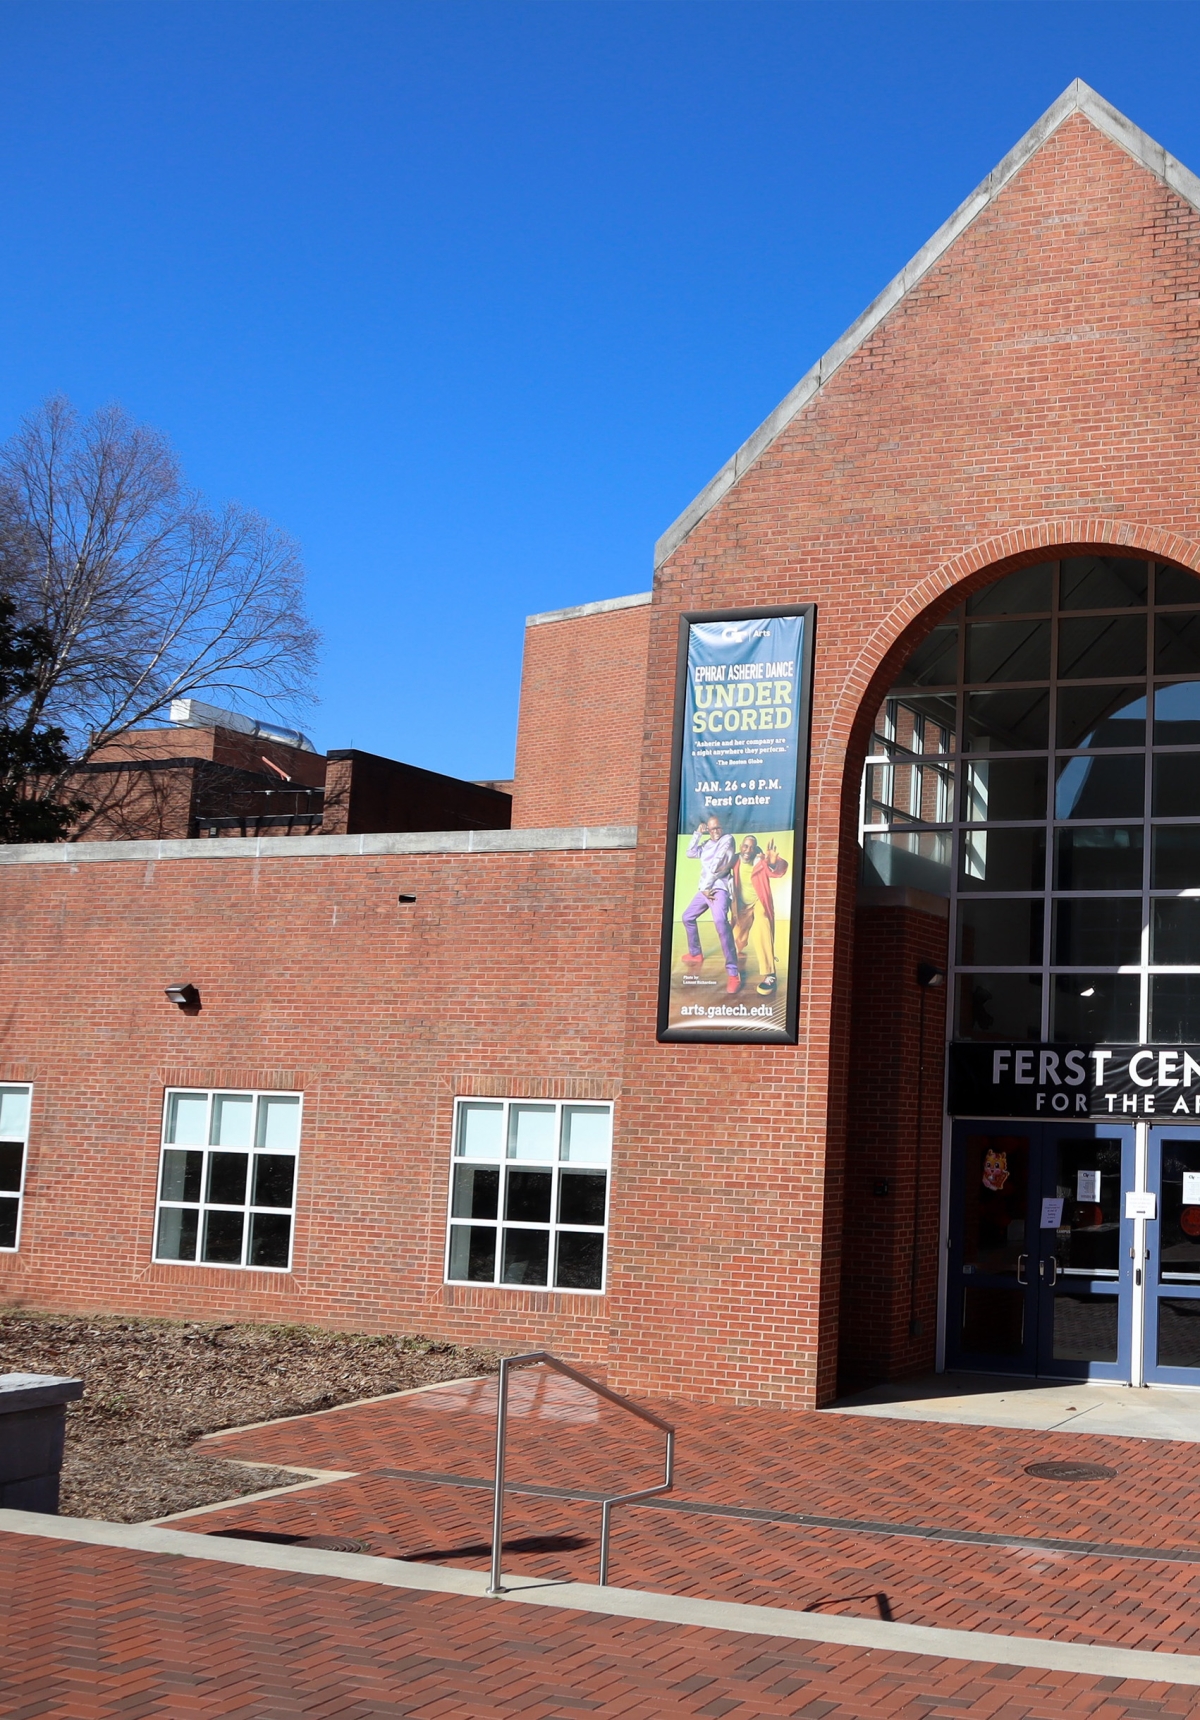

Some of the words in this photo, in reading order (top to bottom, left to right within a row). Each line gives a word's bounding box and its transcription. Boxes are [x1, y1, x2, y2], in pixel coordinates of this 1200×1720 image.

[753, 629, 770, 638] Arts
[695, 664, 726, 682] EPHRAT
[728, 662, 764, 681] ASHERIE
[766, 660, 794, 678] DANCE
[694, 680, 792, 708] UNDER
[692, 706, 792, 734] SCORED
[696, 750, 712, 758] sight
[713, 748, 744, 756] anywhere
[744, 747, 758, 755] they
[695, 780, 722, 792] JAN.
[724, 780, 738, 791] 26
[748, 780, 756, 790] 8
[758, 779, 782, 790] P.M.
[704, 796, 734, 806] Ferst
[734, 794, 771, 806] Center
[680, 1004, 773, 1018] arts.gatech.edu
[992, 1050, 1112, 1087] FERST
[1036, 1093, 1088, 1112] FOR
[1104, 1093, 1156, 1114] THE
